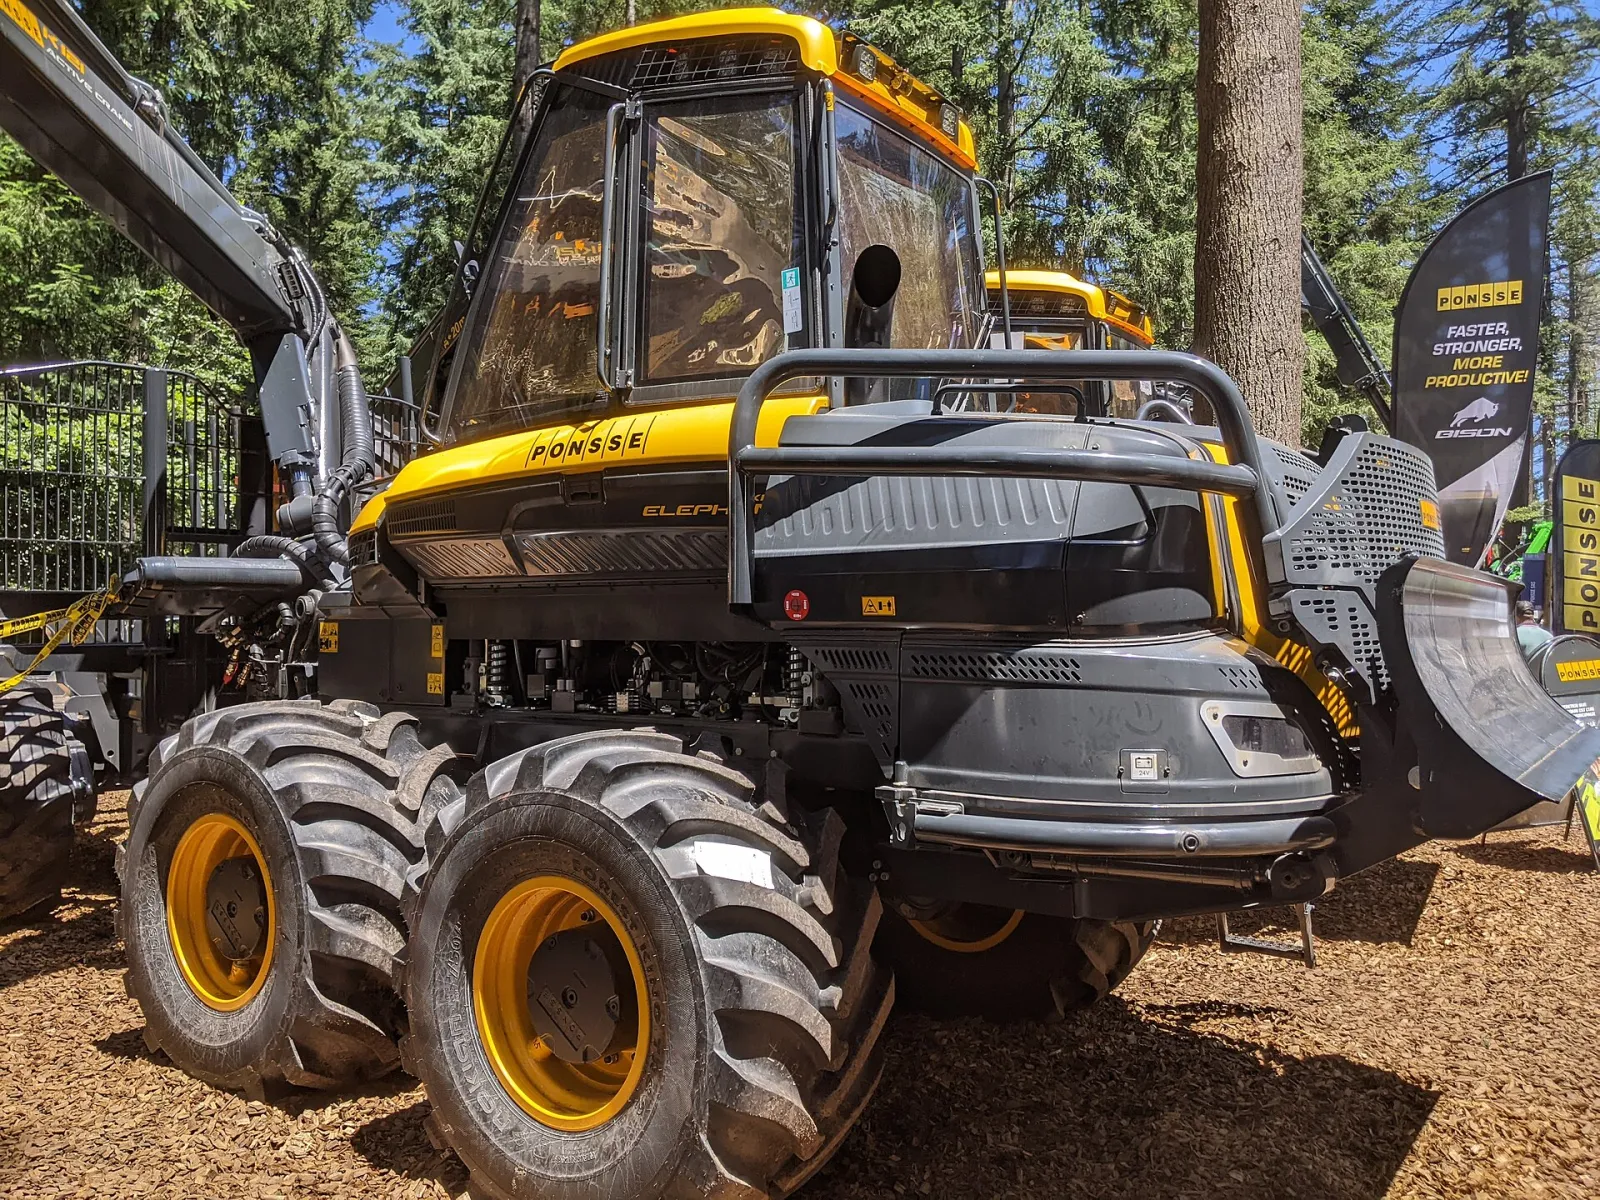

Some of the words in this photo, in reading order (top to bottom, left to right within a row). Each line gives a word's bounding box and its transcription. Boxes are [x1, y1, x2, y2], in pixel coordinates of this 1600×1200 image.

[46, 47, 93, 94] ACTIVE
[94, 91, 134, 132] CRANE
[1440, 290, 1519, 307] PONSSE
[1447, 322, 1509, 339] FASTER,
[1432, 337, 1523, 356] STRONGER,
[1453, 355, 1503, 371] MORE
[1425, 370, 1529, 389] PRODUCTIVE!
[1434, 427, 1513, 440] BISON
[531, 432, 644, 461] PONSSE
[642, 502, 763, 516] ELEPH
[1578, 482, 1599, 628] PONSSE
[1560, 667, 1600, 679] PONSSE
